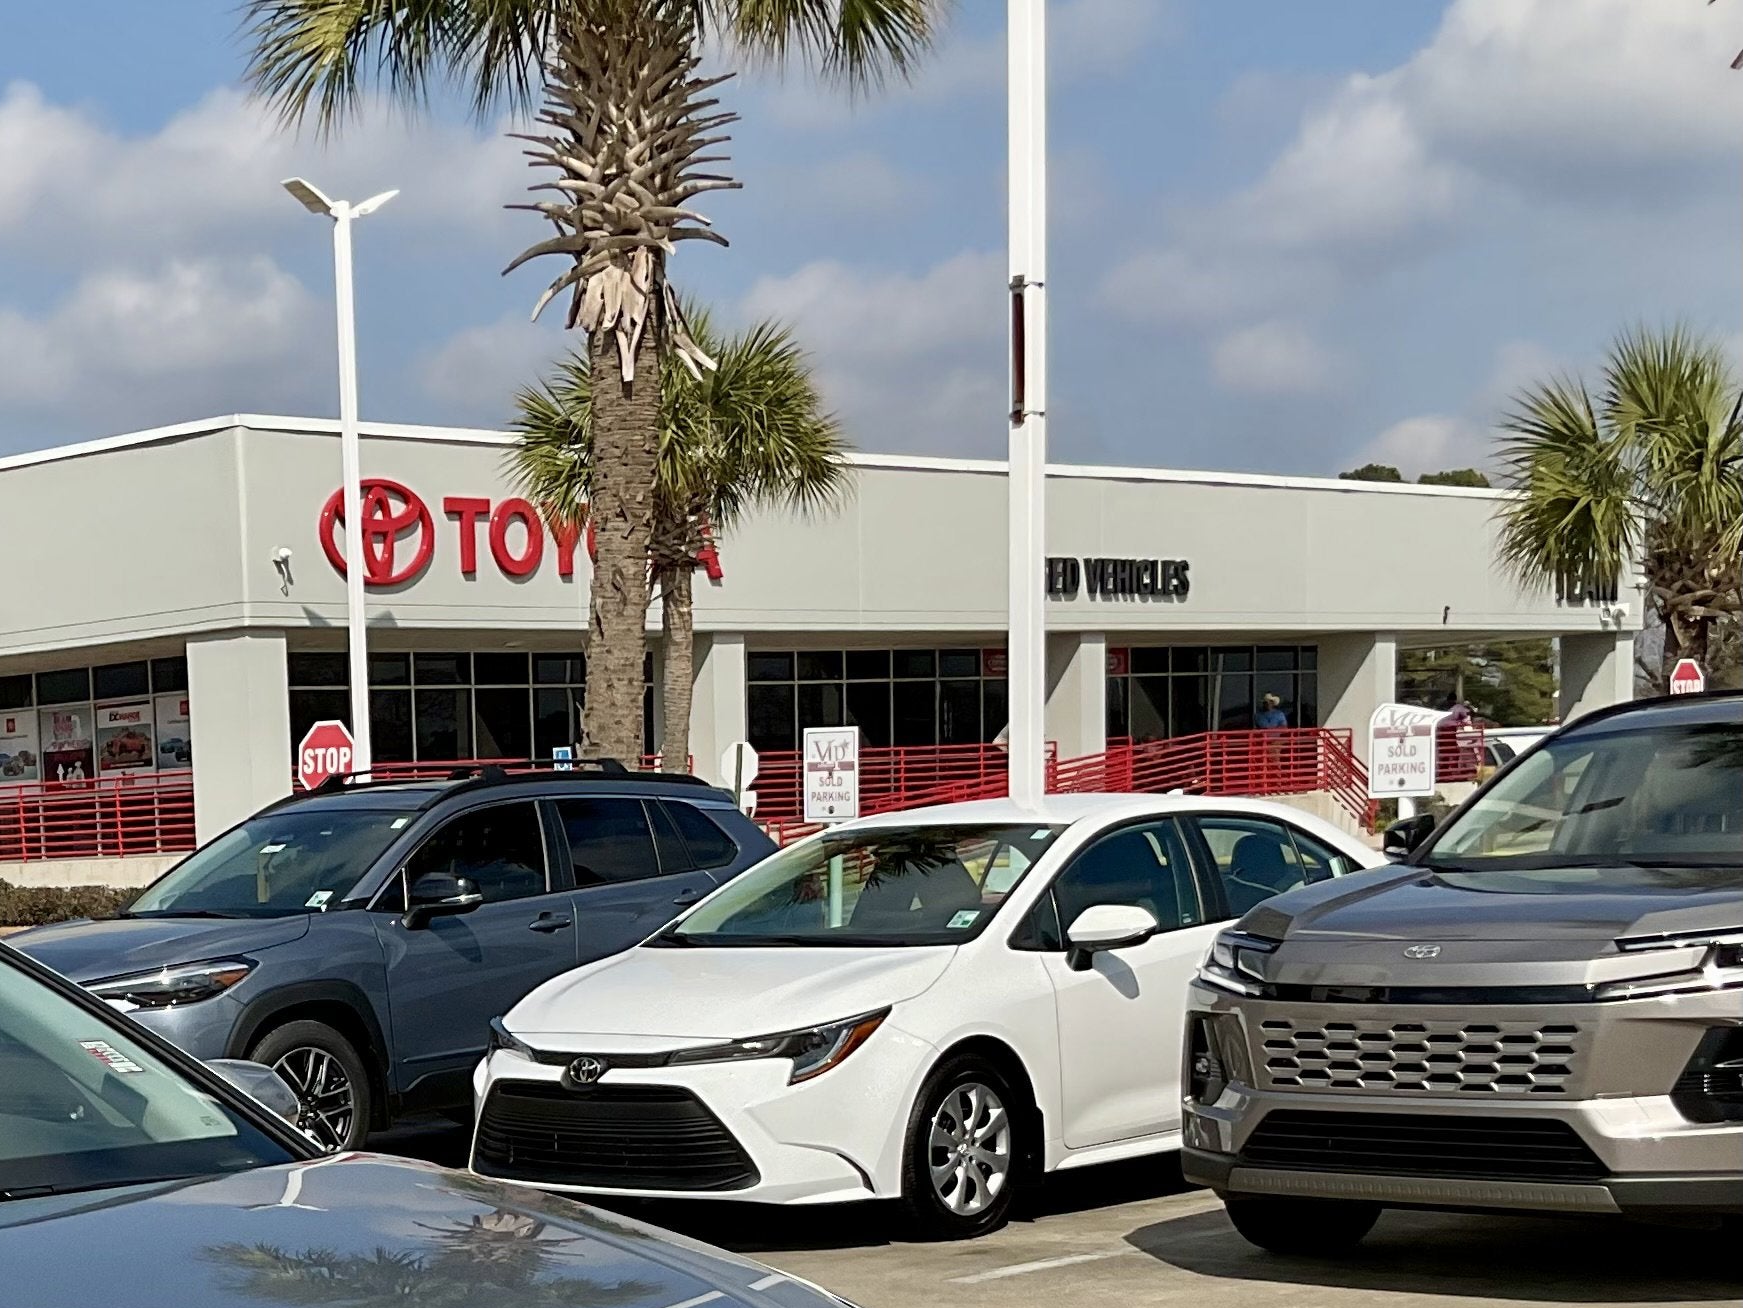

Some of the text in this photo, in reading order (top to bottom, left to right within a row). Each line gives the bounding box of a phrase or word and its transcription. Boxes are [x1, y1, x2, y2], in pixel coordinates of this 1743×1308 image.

[443, 496, 723, 579] TOY
[1083, 558, 1190, 595] VEHICLES
[1387, 745, 1417, 757] SOLD
[303, 747, 351, 775] STOP
[1378, 762, 1426, 775] PARKING
[819, 776, 843, 787] SOLD
[811, 791, 851, 802] PARKING
